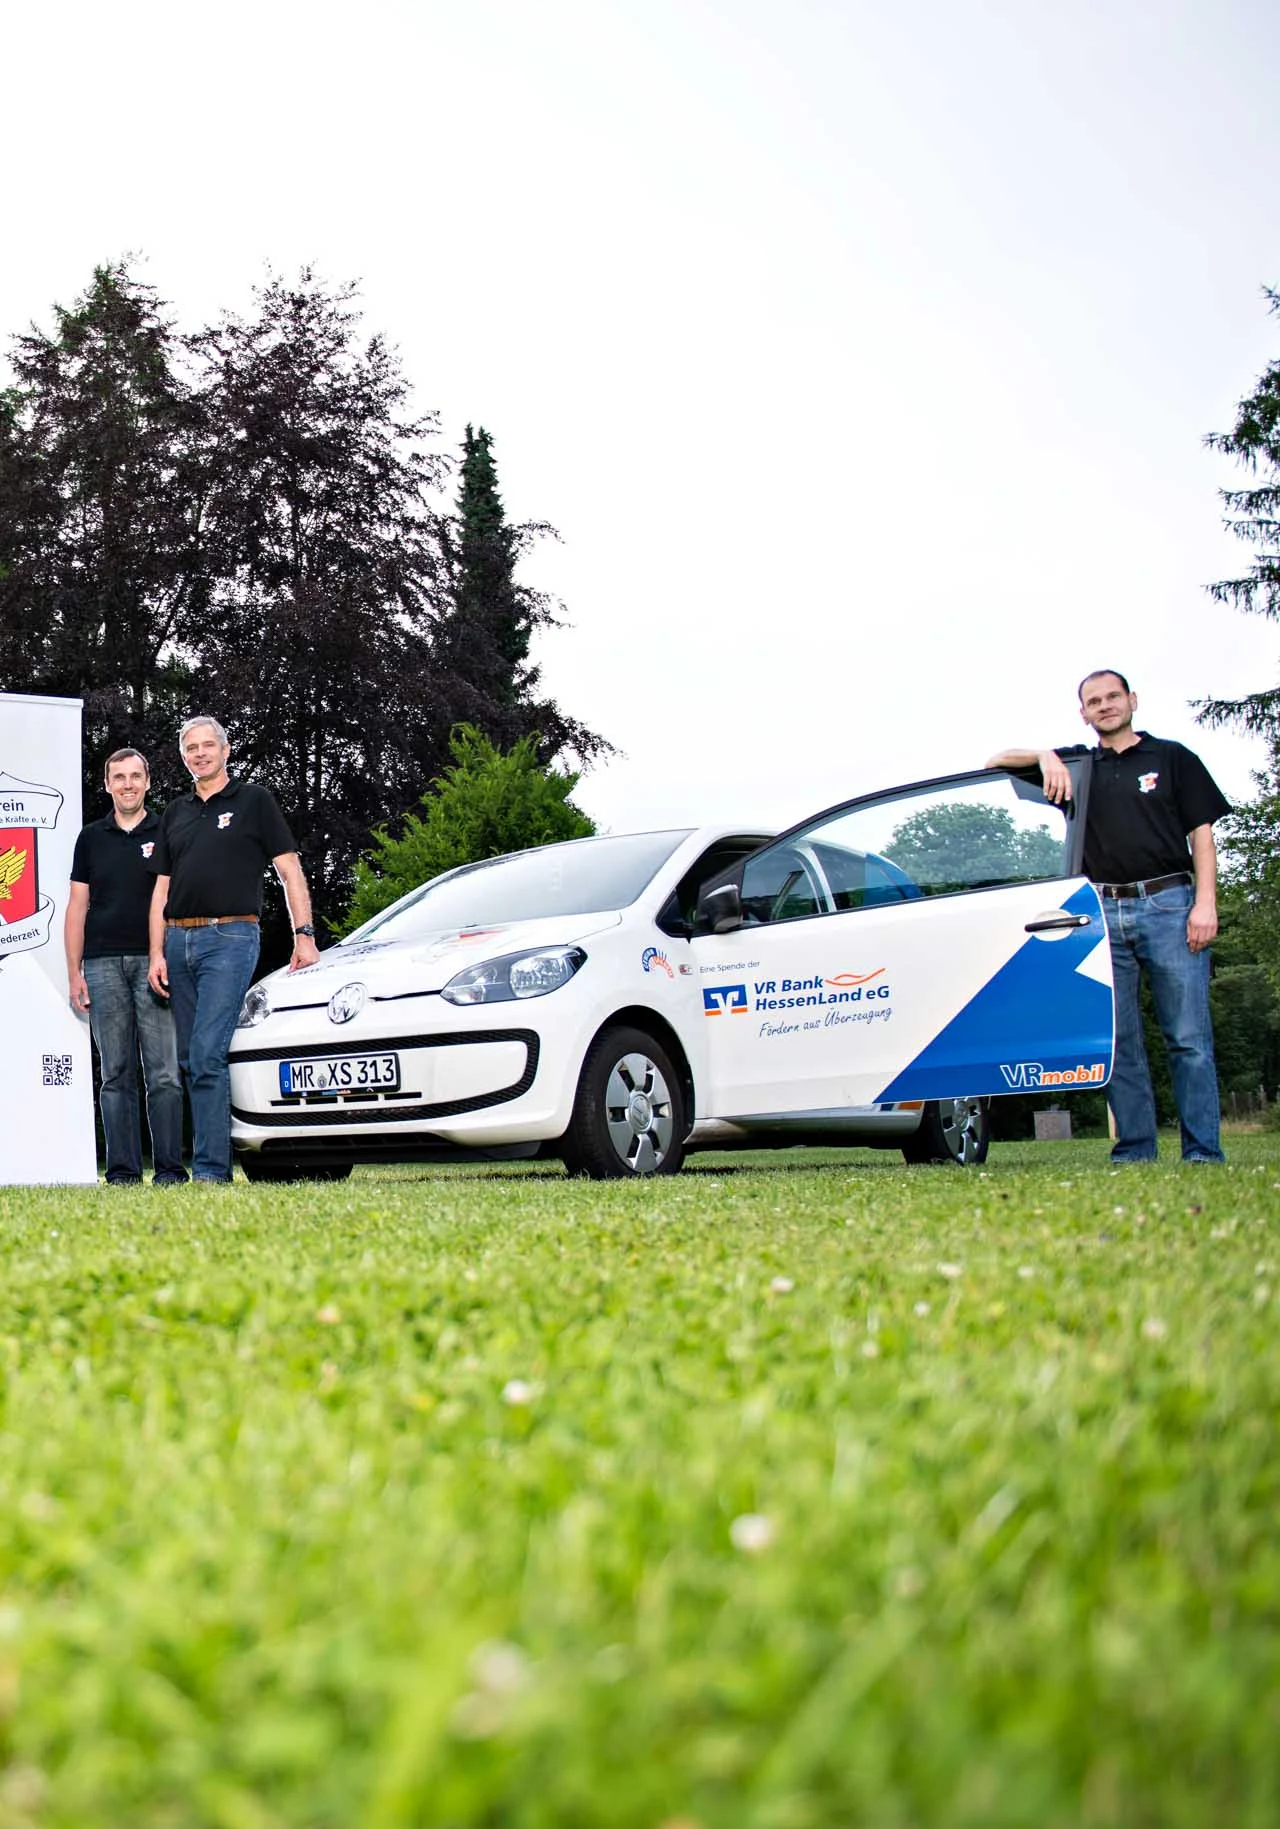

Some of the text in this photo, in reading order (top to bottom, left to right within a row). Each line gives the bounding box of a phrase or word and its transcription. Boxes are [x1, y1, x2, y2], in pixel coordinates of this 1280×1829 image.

[5, 814, 30, 823] Kräfte
[717, 964, 746, 973] Spende
[747, 960, 760, 969] der
[754, 975, 824, 994] VR Bank
[755, 985, 890, 1011] HessenLand eG
[759, 1007, 893, 1038] Fördern aus Überzeugung
[292, 1065, 315, 1089] MR
[328, 1062, 352, 1086] XS
[357, 1058, 394, 1084] 313
[1000, 1062, 1105, 1088] VRmobil
